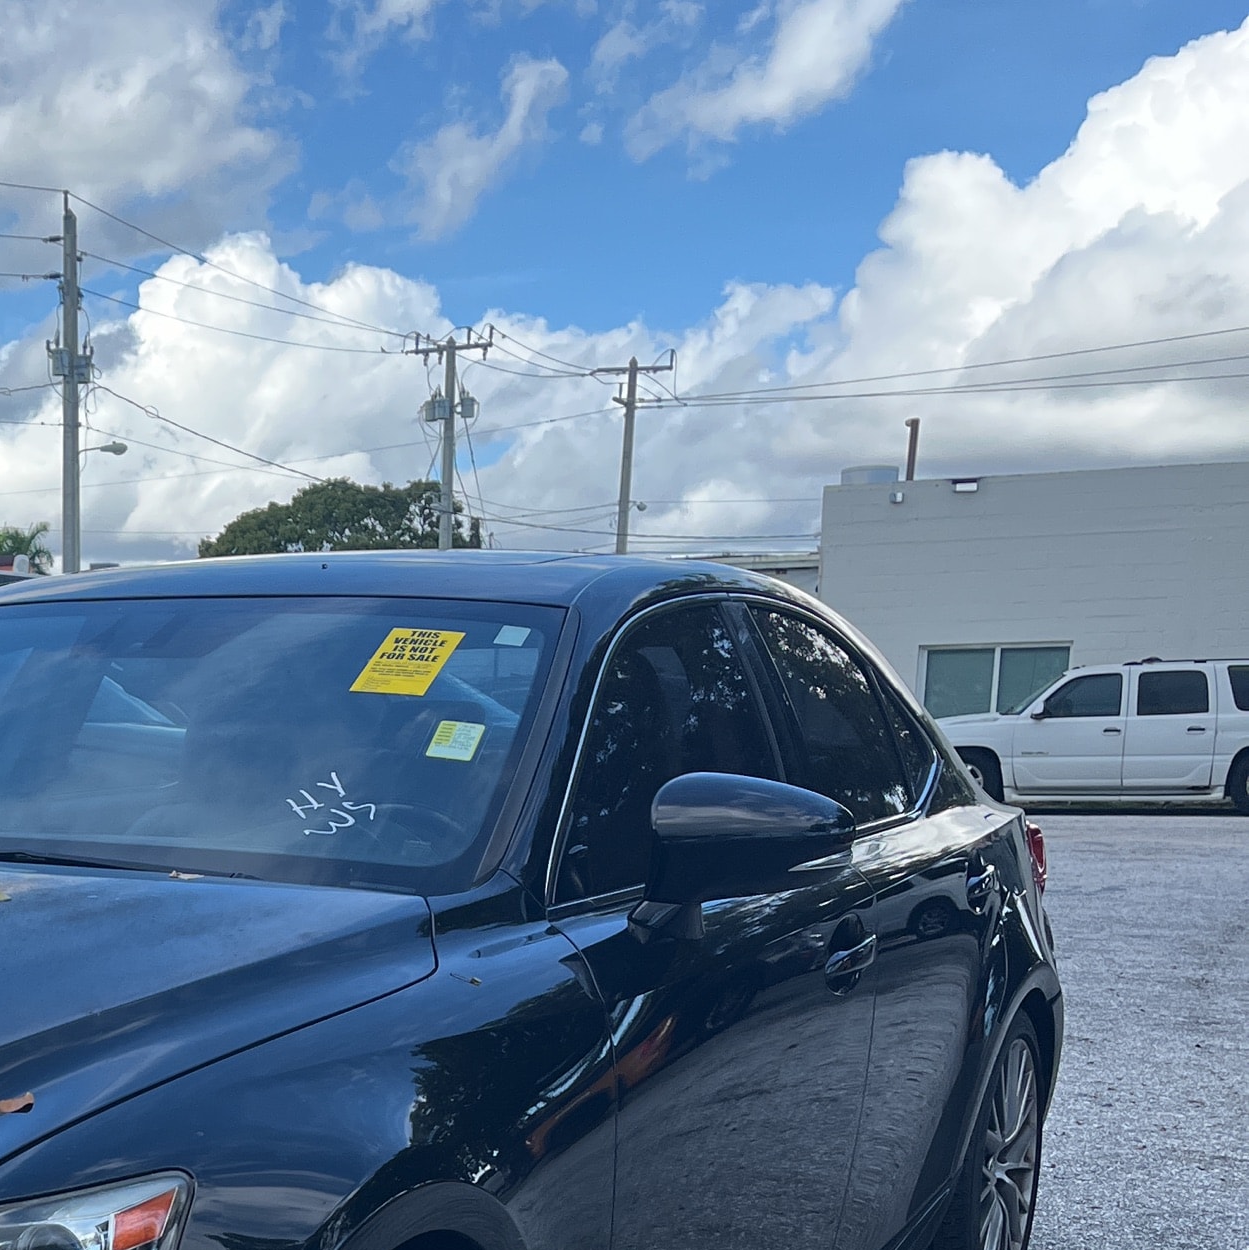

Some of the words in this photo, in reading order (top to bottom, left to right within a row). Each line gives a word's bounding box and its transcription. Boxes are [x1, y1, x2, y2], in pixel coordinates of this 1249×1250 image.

[410, 630, 441, 639] THIS
[393, 637, 448, 647] VEHICLE
[392, 645, 407, 653] IS
[408, 646, 438, 655] NOT
[379, 652, 406, 660] FOR
[407, 653, 441, 663] SALE
